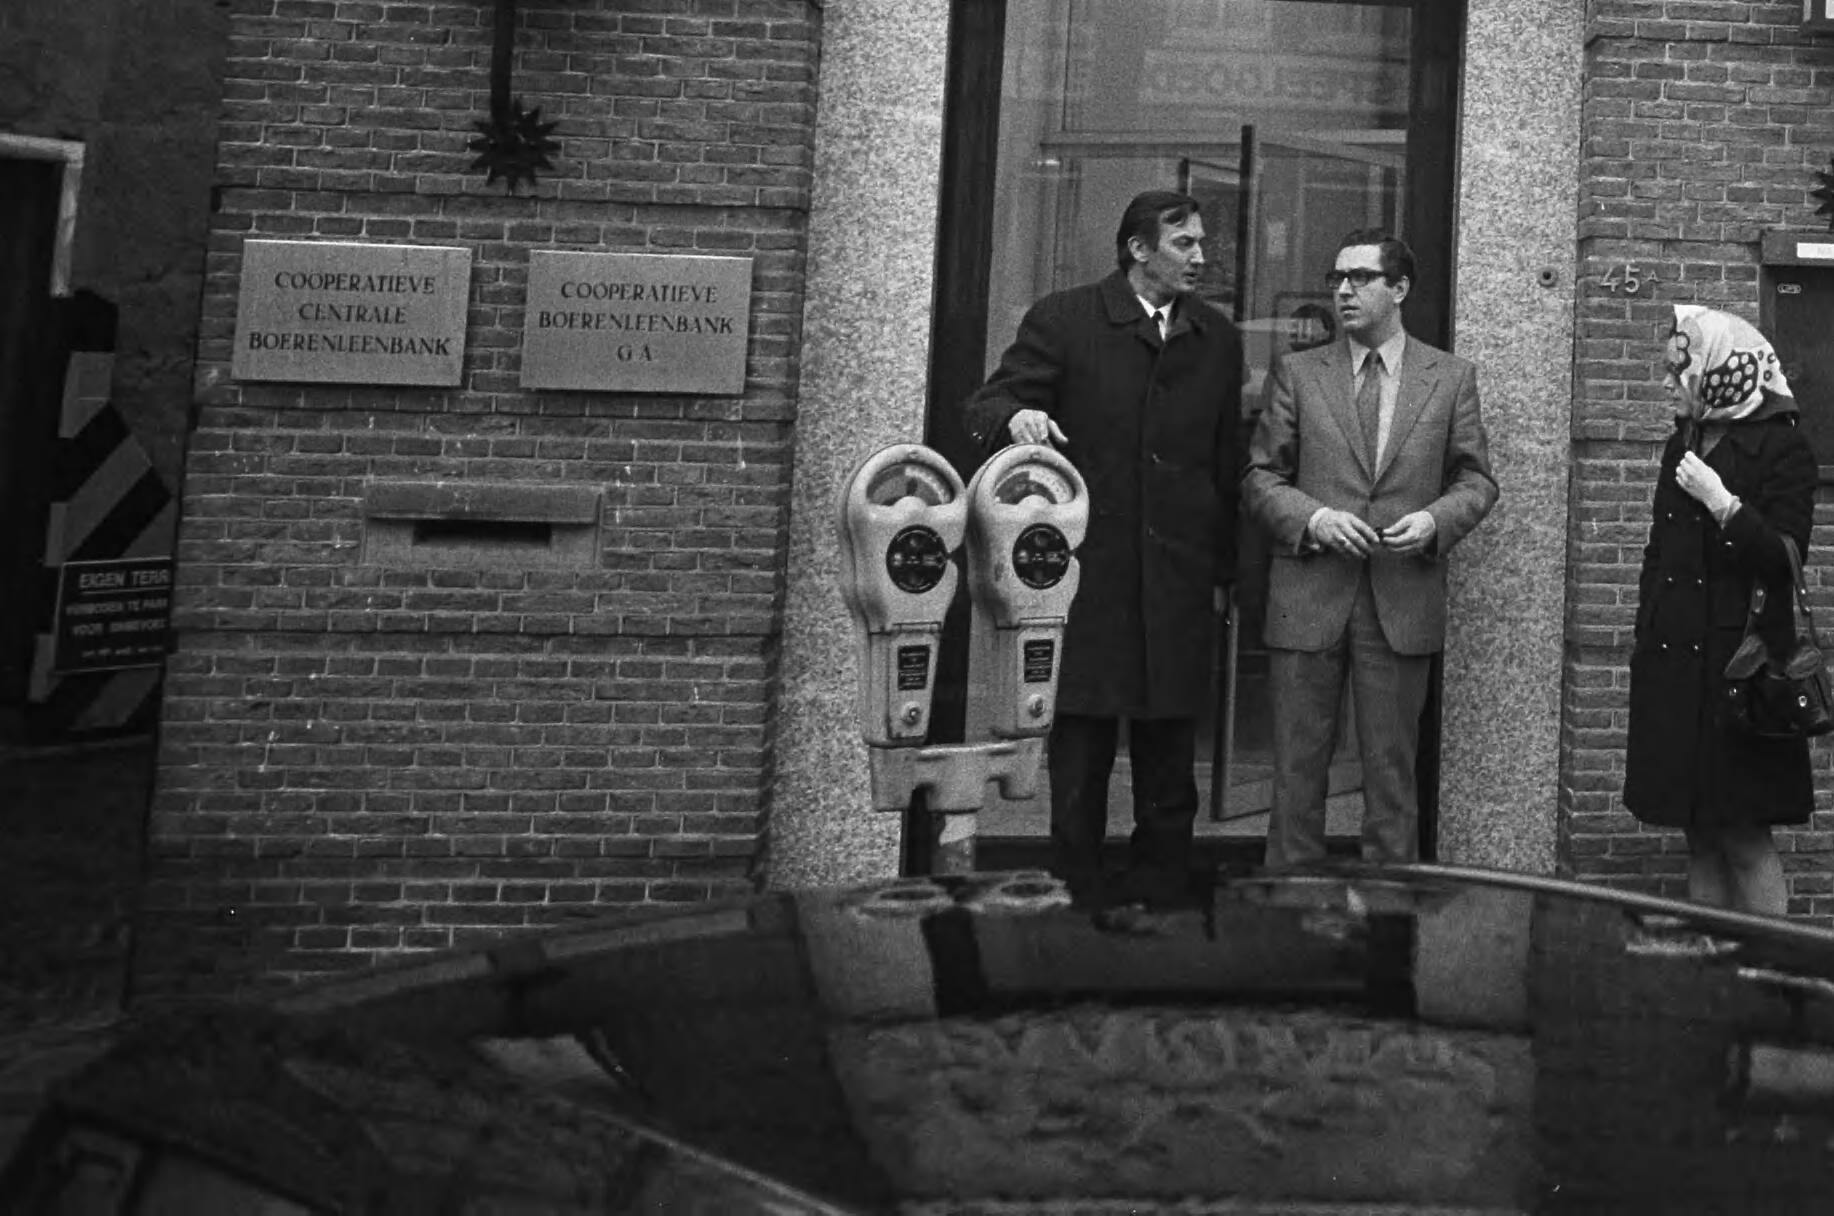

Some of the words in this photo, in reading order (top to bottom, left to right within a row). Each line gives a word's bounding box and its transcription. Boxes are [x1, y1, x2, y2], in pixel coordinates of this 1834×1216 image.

[275, 271, 435, 294] COOPERATIEVE
[561, 281, 717, 303] COOPERATIEVE
[299, 302, 406, 324] CENTRALE
[538, 311, 733, 334] BOERENLEENBANK
[249, 332, 450, 355] BOERENLEENBANK
[79, 572, 127, 589] EIGEN
